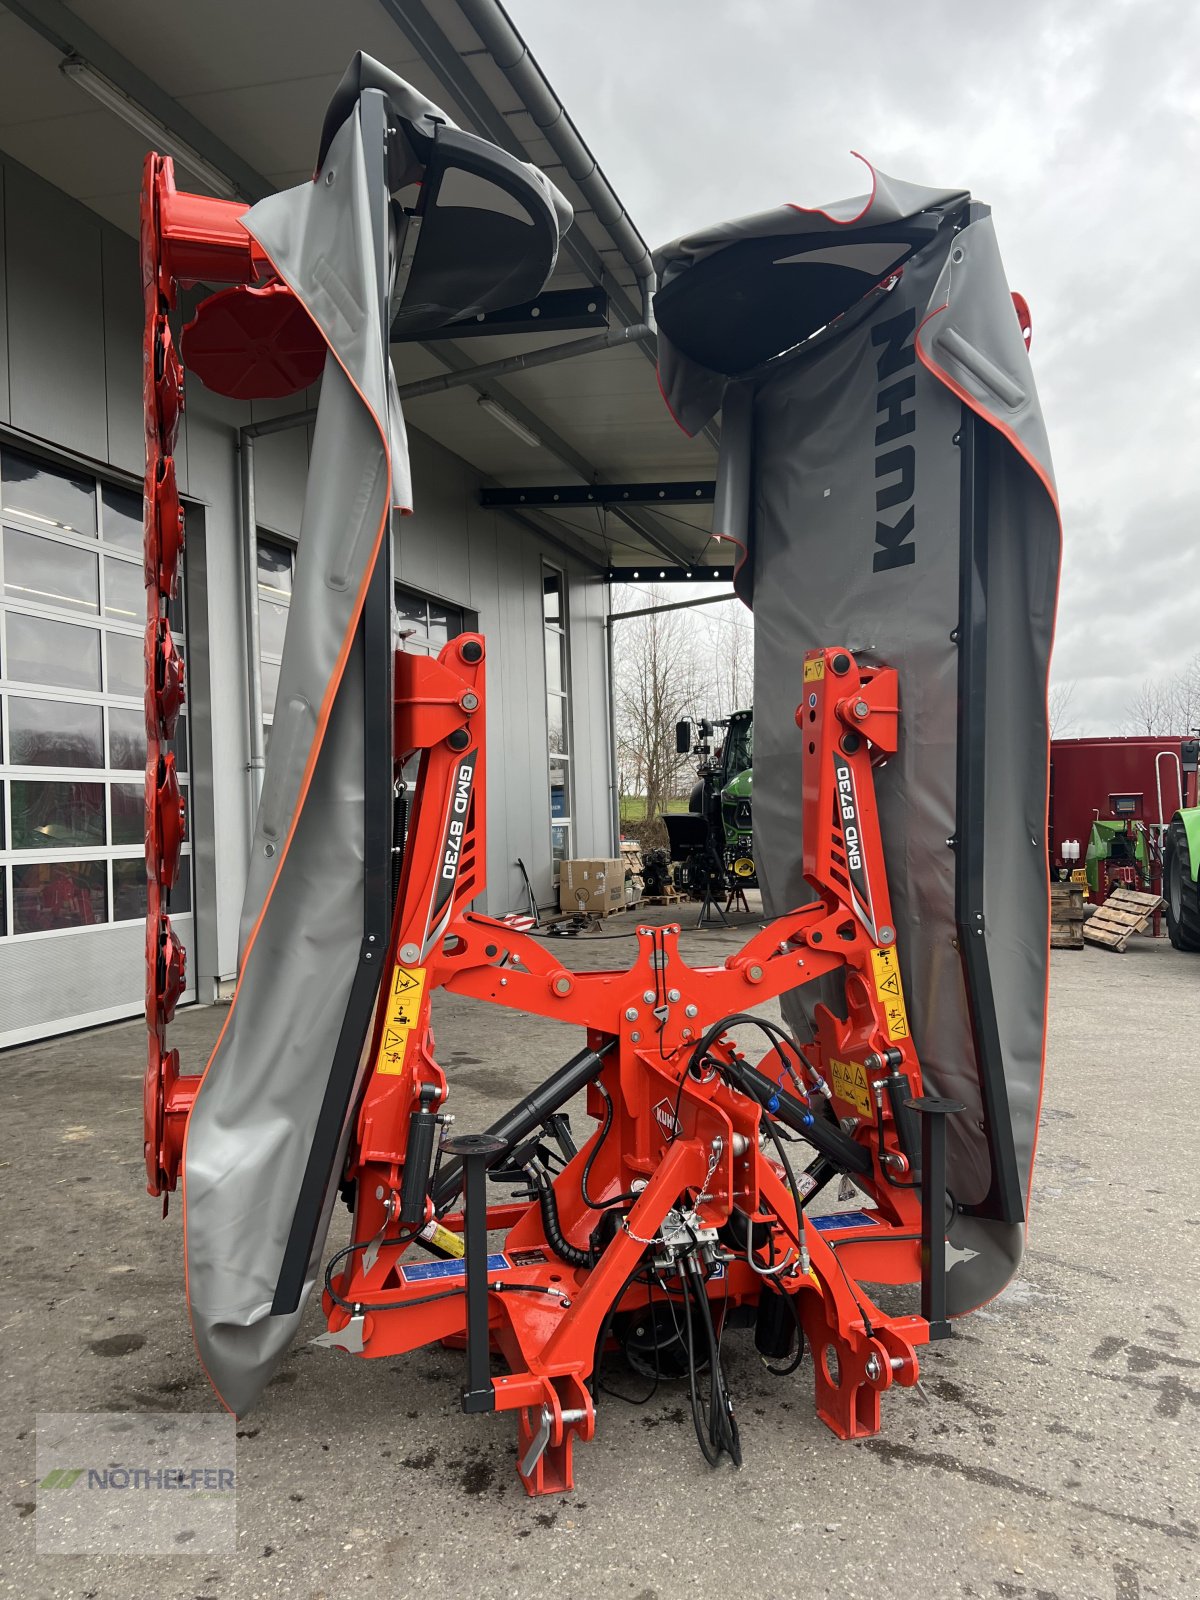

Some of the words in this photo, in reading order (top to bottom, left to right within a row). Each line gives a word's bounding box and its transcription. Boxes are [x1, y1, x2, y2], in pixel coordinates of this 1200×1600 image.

[871, 306, 916, 573] KUHN
[454, 765, 473, 814] GMD
[836, 766, 855, 820] 8730
[442, 820, 464, 880] 8730
[845, 826, 862, 870] GMD
